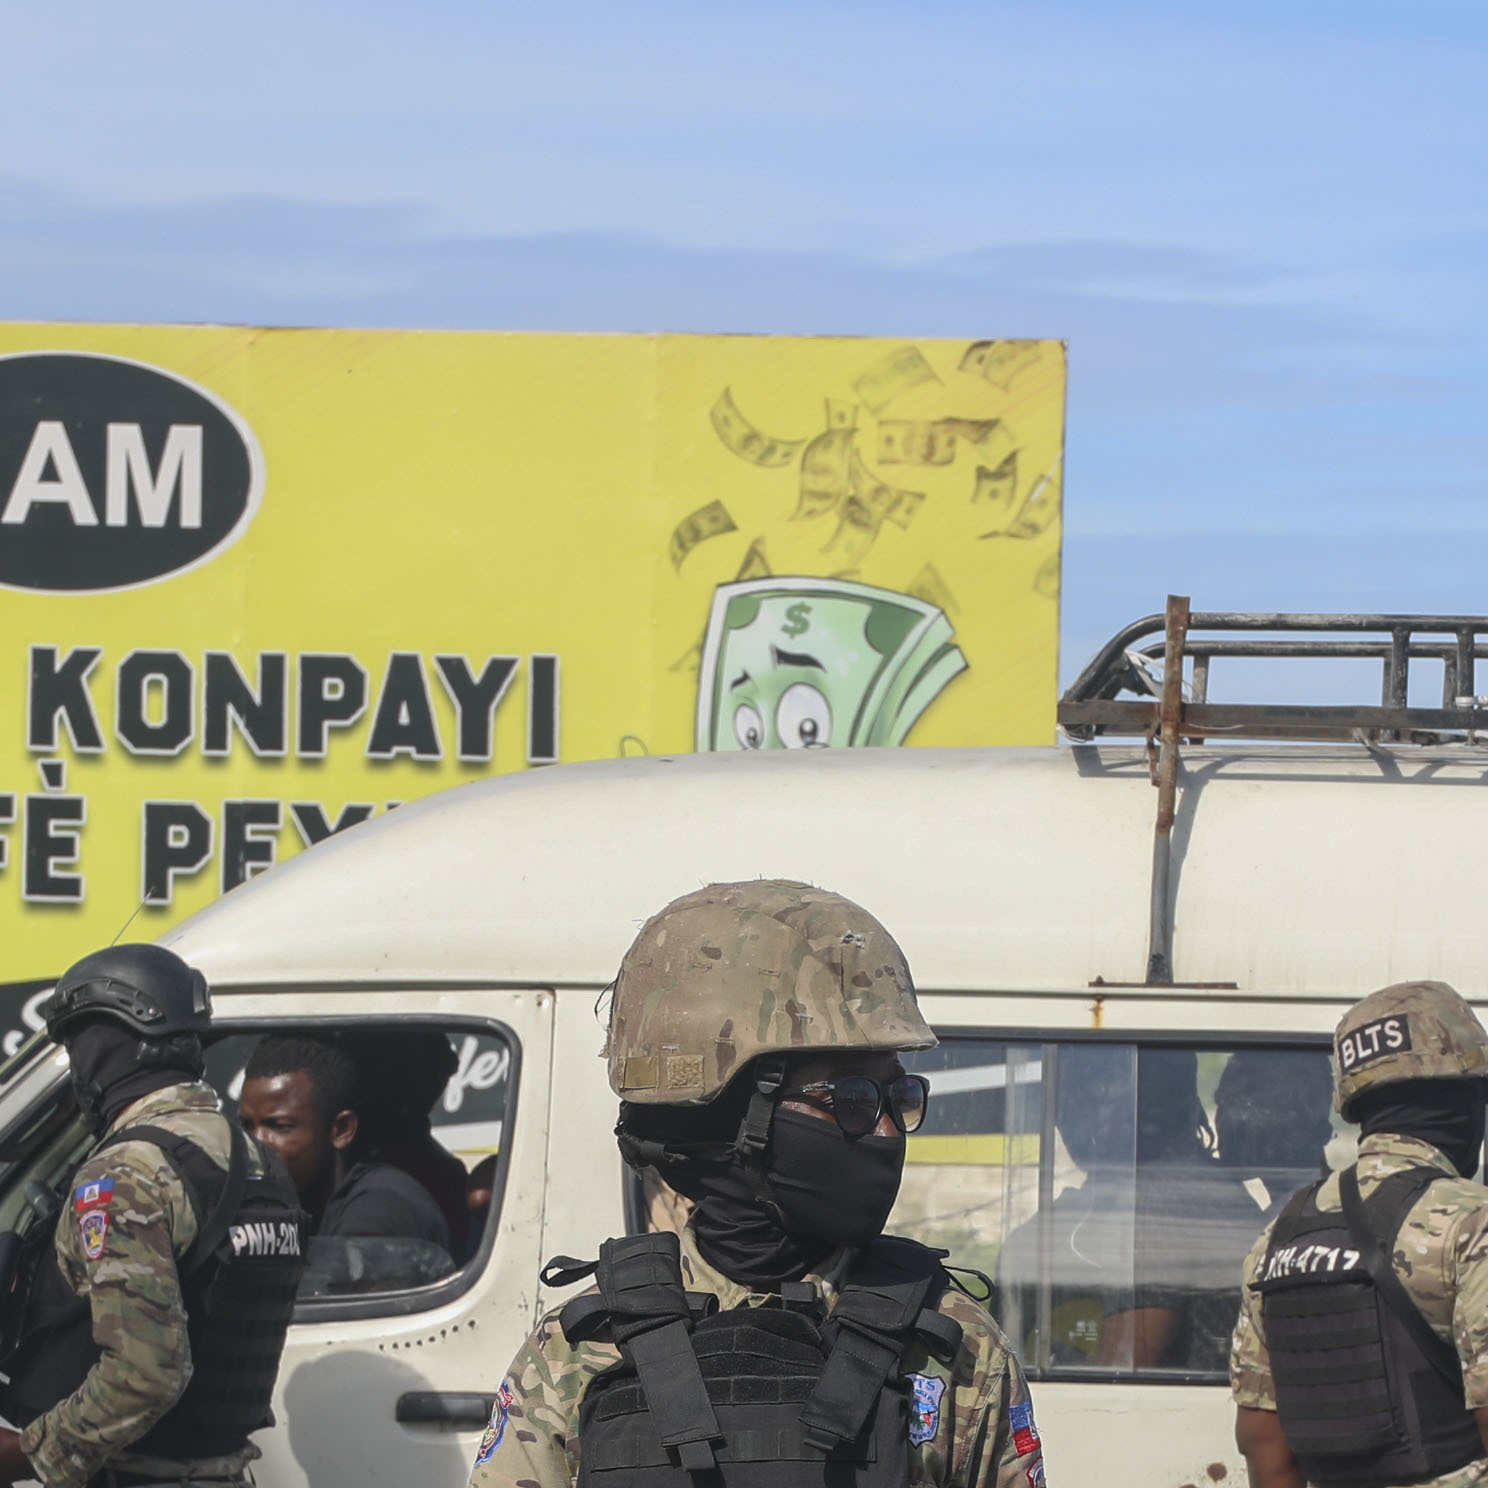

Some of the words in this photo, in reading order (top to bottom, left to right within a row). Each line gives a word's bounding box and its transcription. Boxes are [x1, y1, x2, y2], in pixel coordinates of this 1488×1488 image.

[27, 645, 559, 764] KONPAYI
[140, 800, 408, 906] PE
[1341, 1019, 1404, 1068] BLTS
